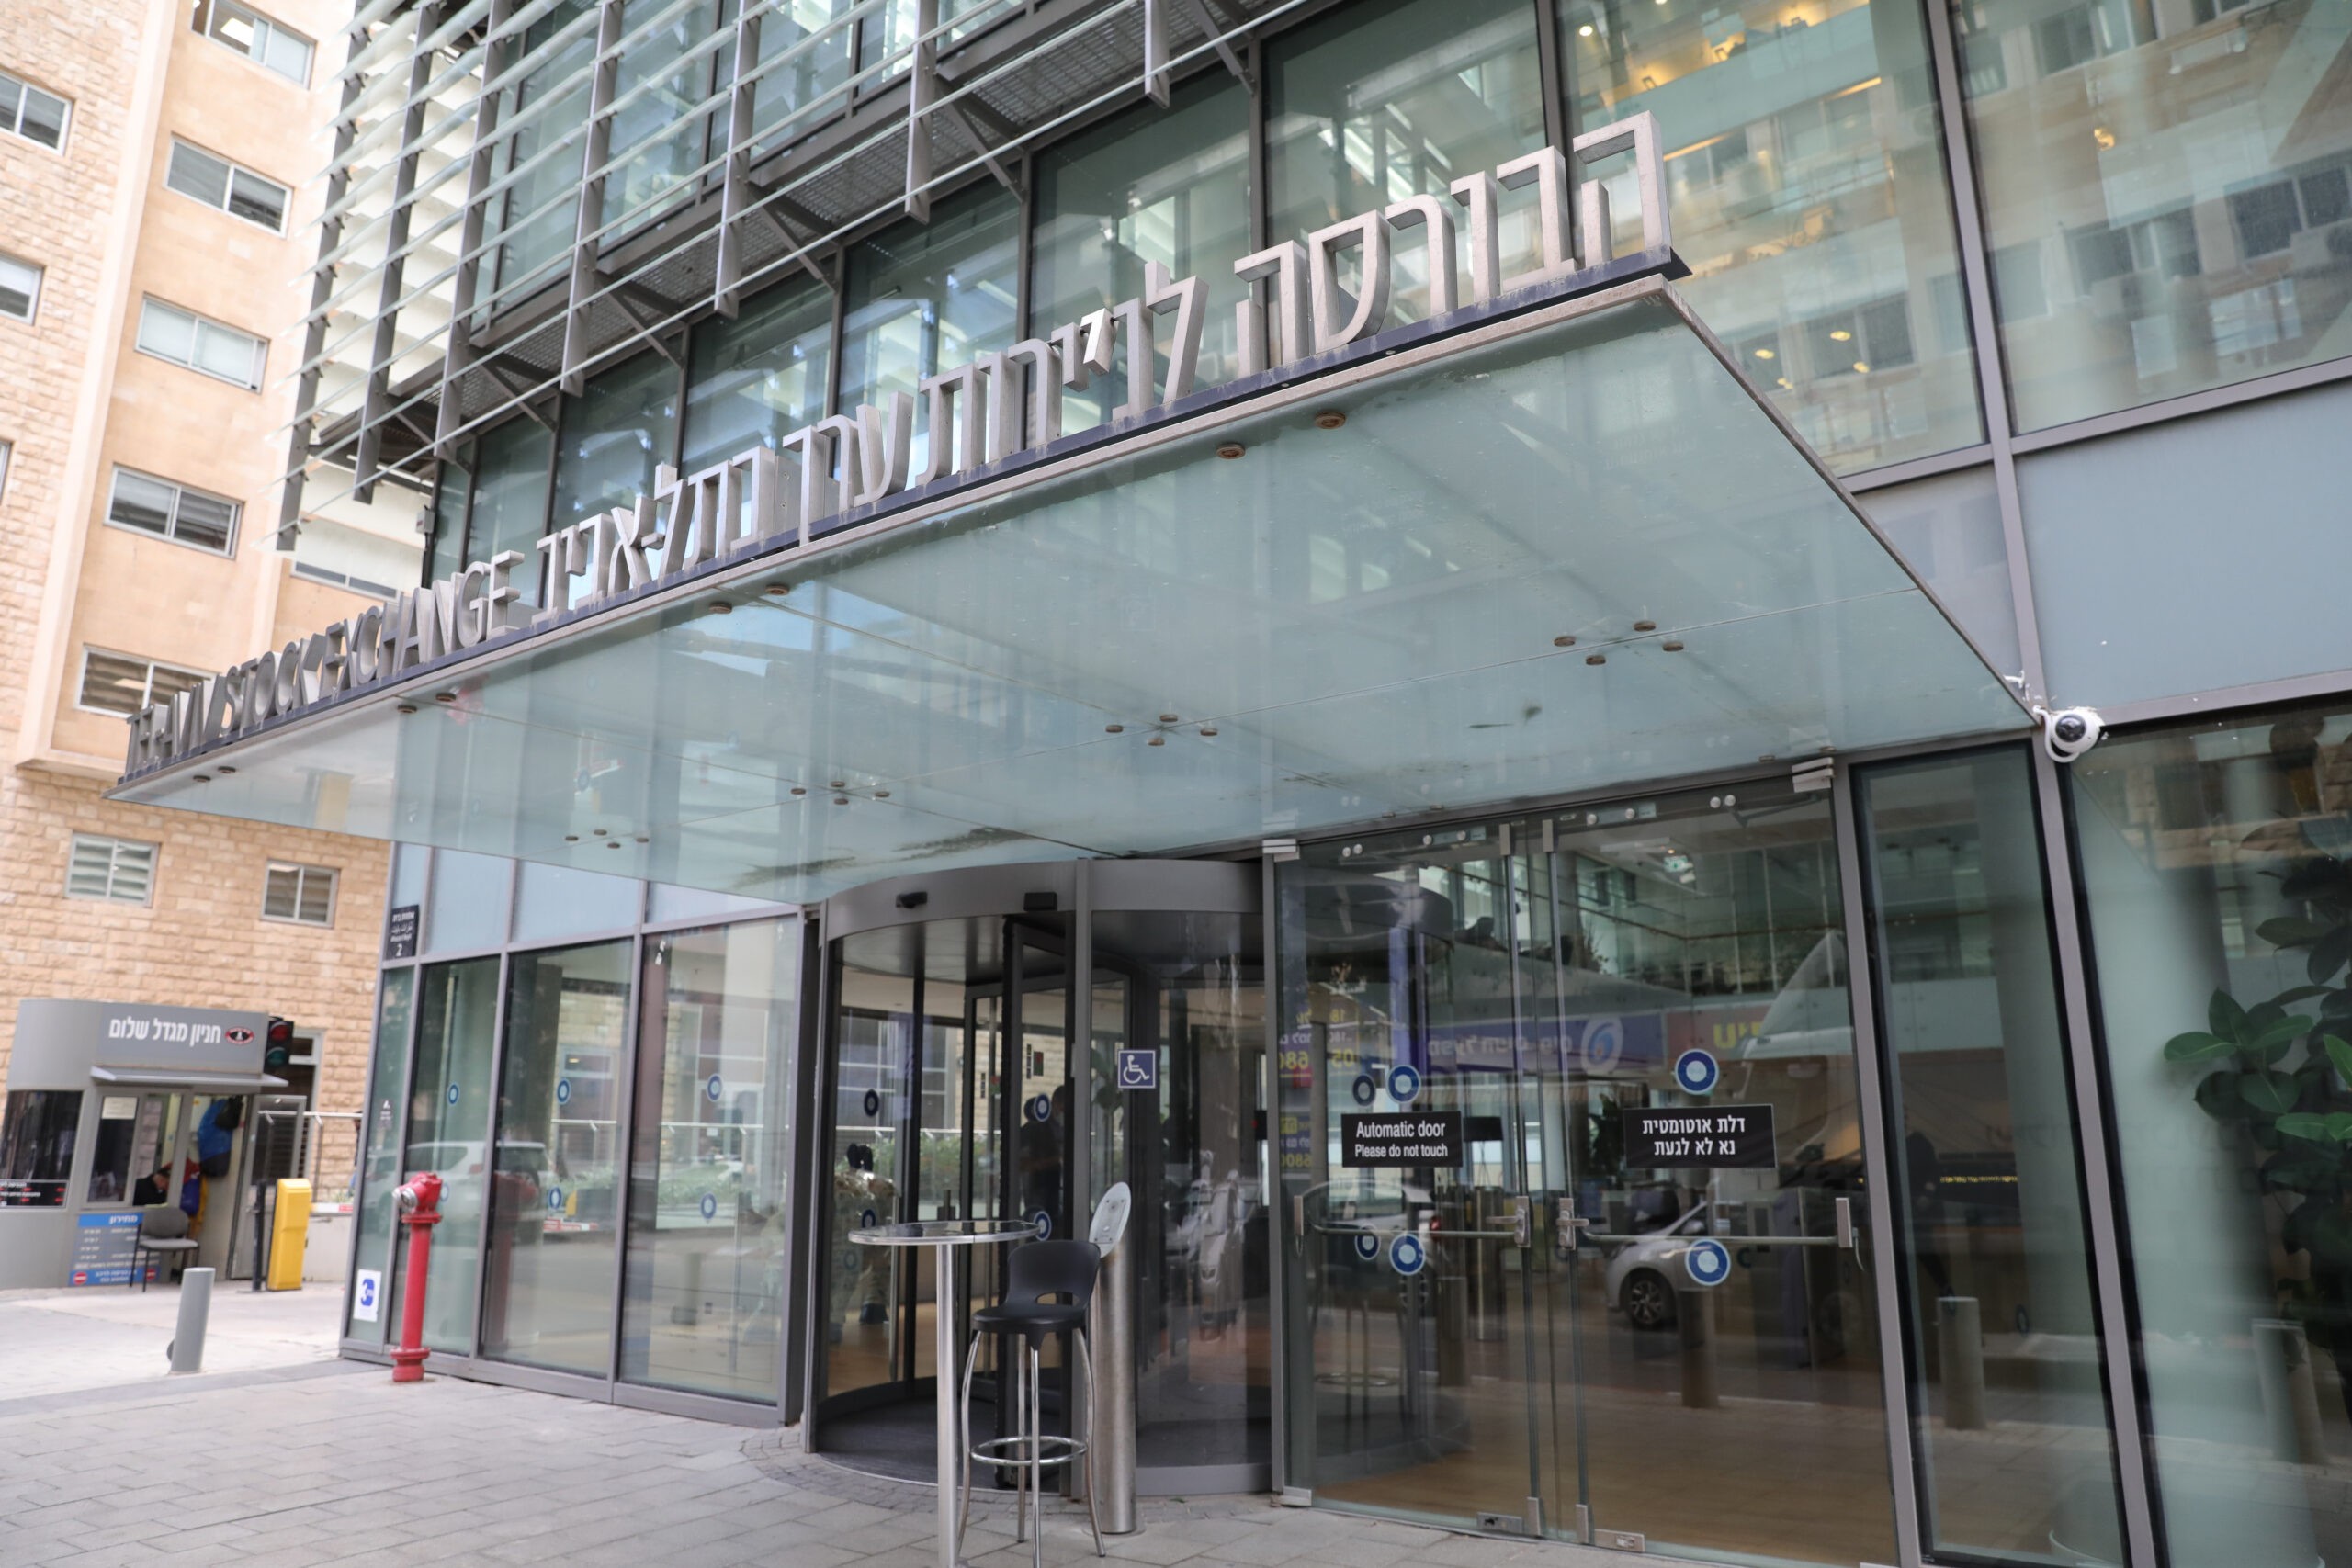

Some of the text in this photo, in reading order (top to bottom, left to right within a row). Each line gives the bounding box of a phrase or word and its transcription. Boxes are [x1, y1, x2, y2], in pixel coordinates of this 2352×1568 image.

[1234, 110, 1671, 378] הבורסה
[915, 260, 1209, 488] לניירות
[783, 391, 914, 546] ערך
[220, 632, 324, 737] STOCK
[319, 550, 525, 702] EXCHANGE
[396, 943, 402, 957] 2
[108, 1016, 149, 1040] שלום
[153, 1018, 187, 1042] מגדל
[190, 1024, 221, 1047] חניון
[1356, 1120, 1445, 1138] Automatic door
[1642, 1114, 1746, 1134] דלת אוטומטית
[1355, 1143, 1448, 1157] Please do not touch
[1654, 1137, 1736, 1156] נא לא לגעת
